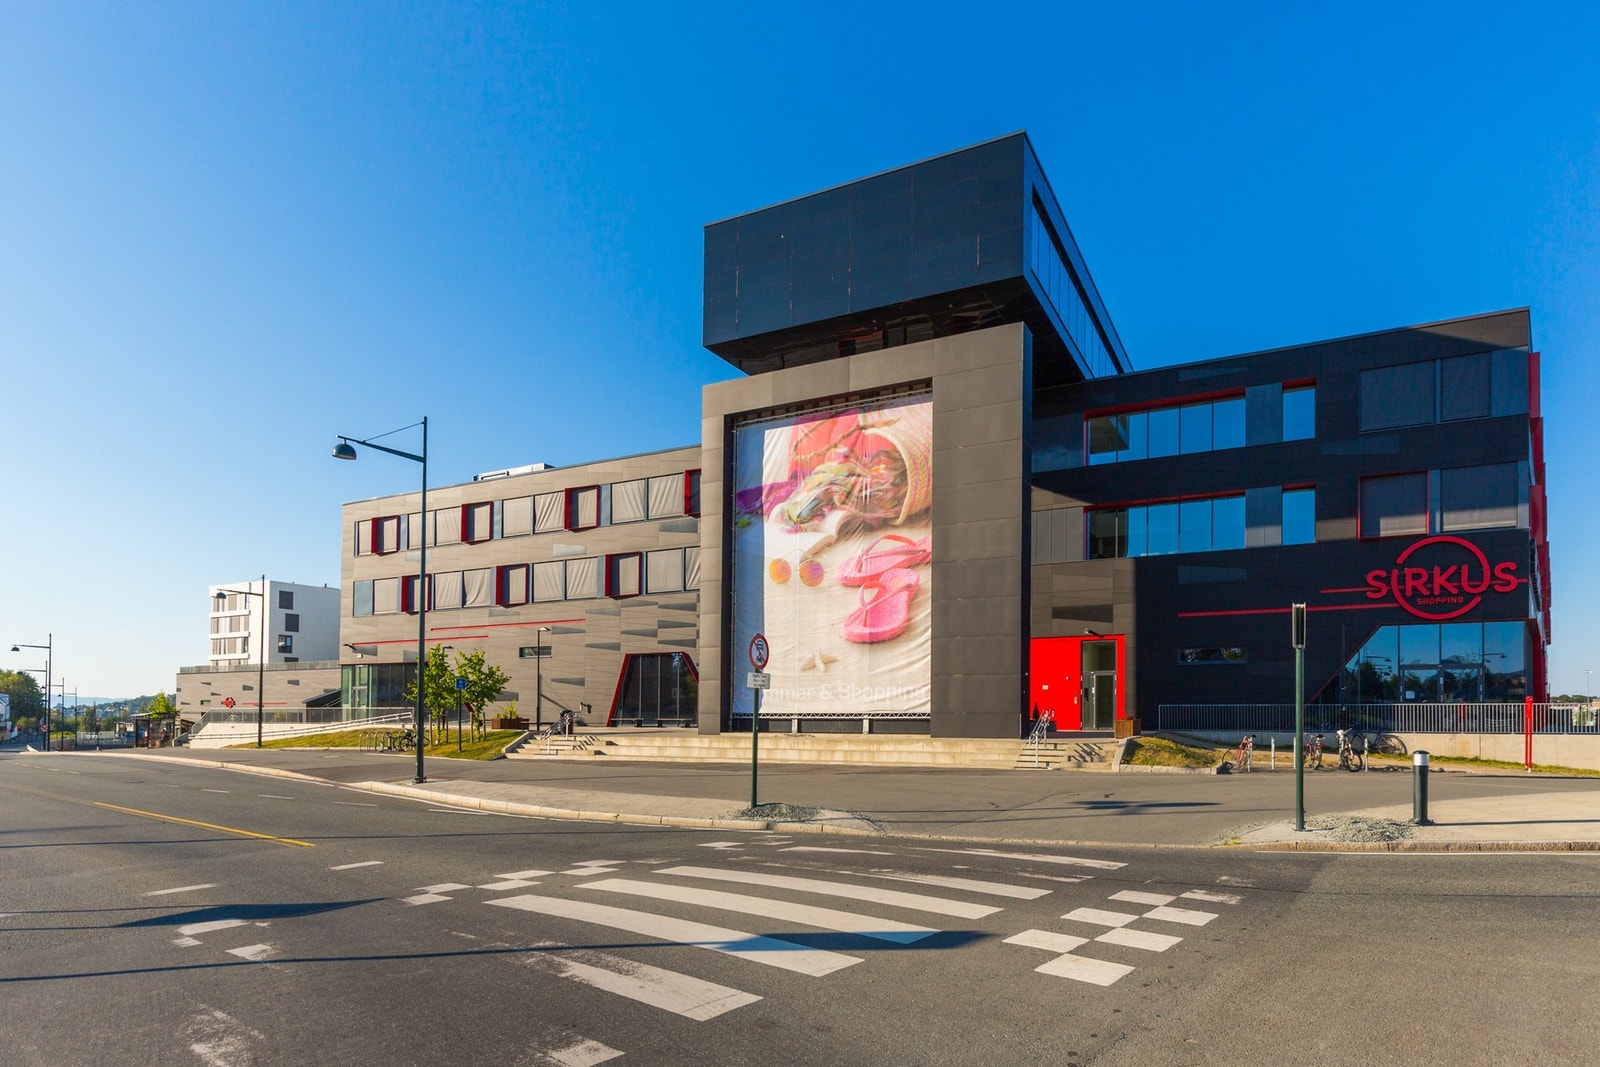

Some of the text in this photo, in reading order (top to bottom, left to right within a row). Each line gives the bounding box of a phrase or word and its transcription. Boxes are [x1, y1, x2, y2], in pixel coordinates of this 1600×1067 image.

[1366, 561, 1518, 599] SIRKUS
[1416, 596, 1464, 606] SHOPPING
[819, 683, 833, 700] &
[838, 682, 925, 704] Shopping
